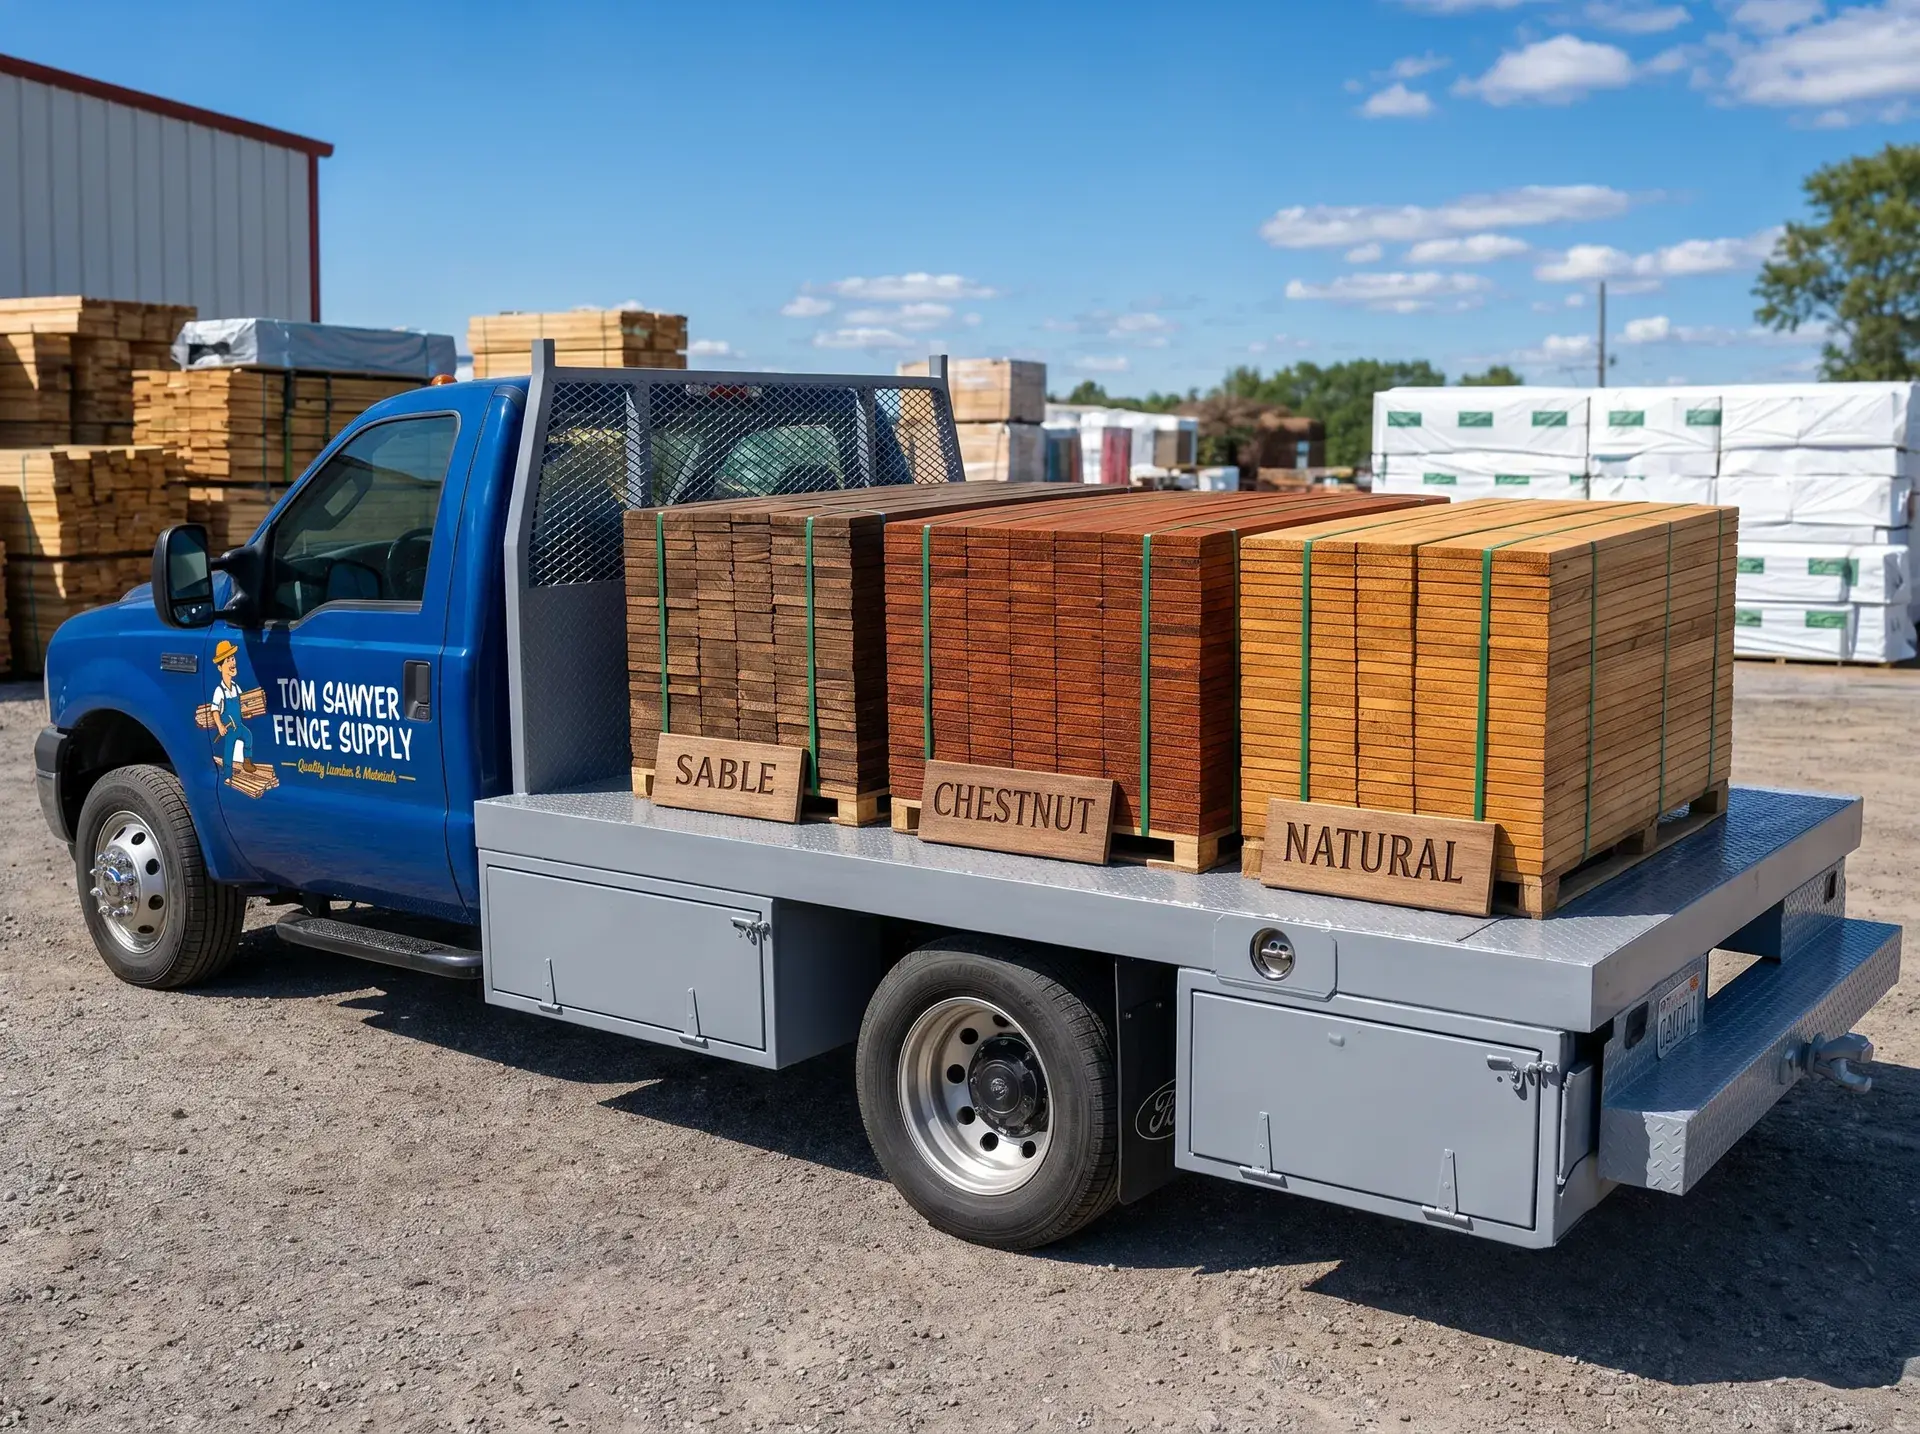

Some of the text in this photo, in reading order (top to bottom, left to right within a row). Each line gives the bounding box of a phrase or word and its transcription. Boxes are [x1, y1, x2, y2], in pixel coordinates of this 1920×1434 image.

[277, 678, 401, 721] TOM SAWYER
[272, 714, 413, 762] FENCE SUPPLY
[297, 758, 325, 779] Quality
[355, 765, 362, 779] &
[676, 754, 777, 795] SABLE
[934, 782, 1096, 835] CHESTNUT
[1284, 822, 1463, 884] NATURAL
